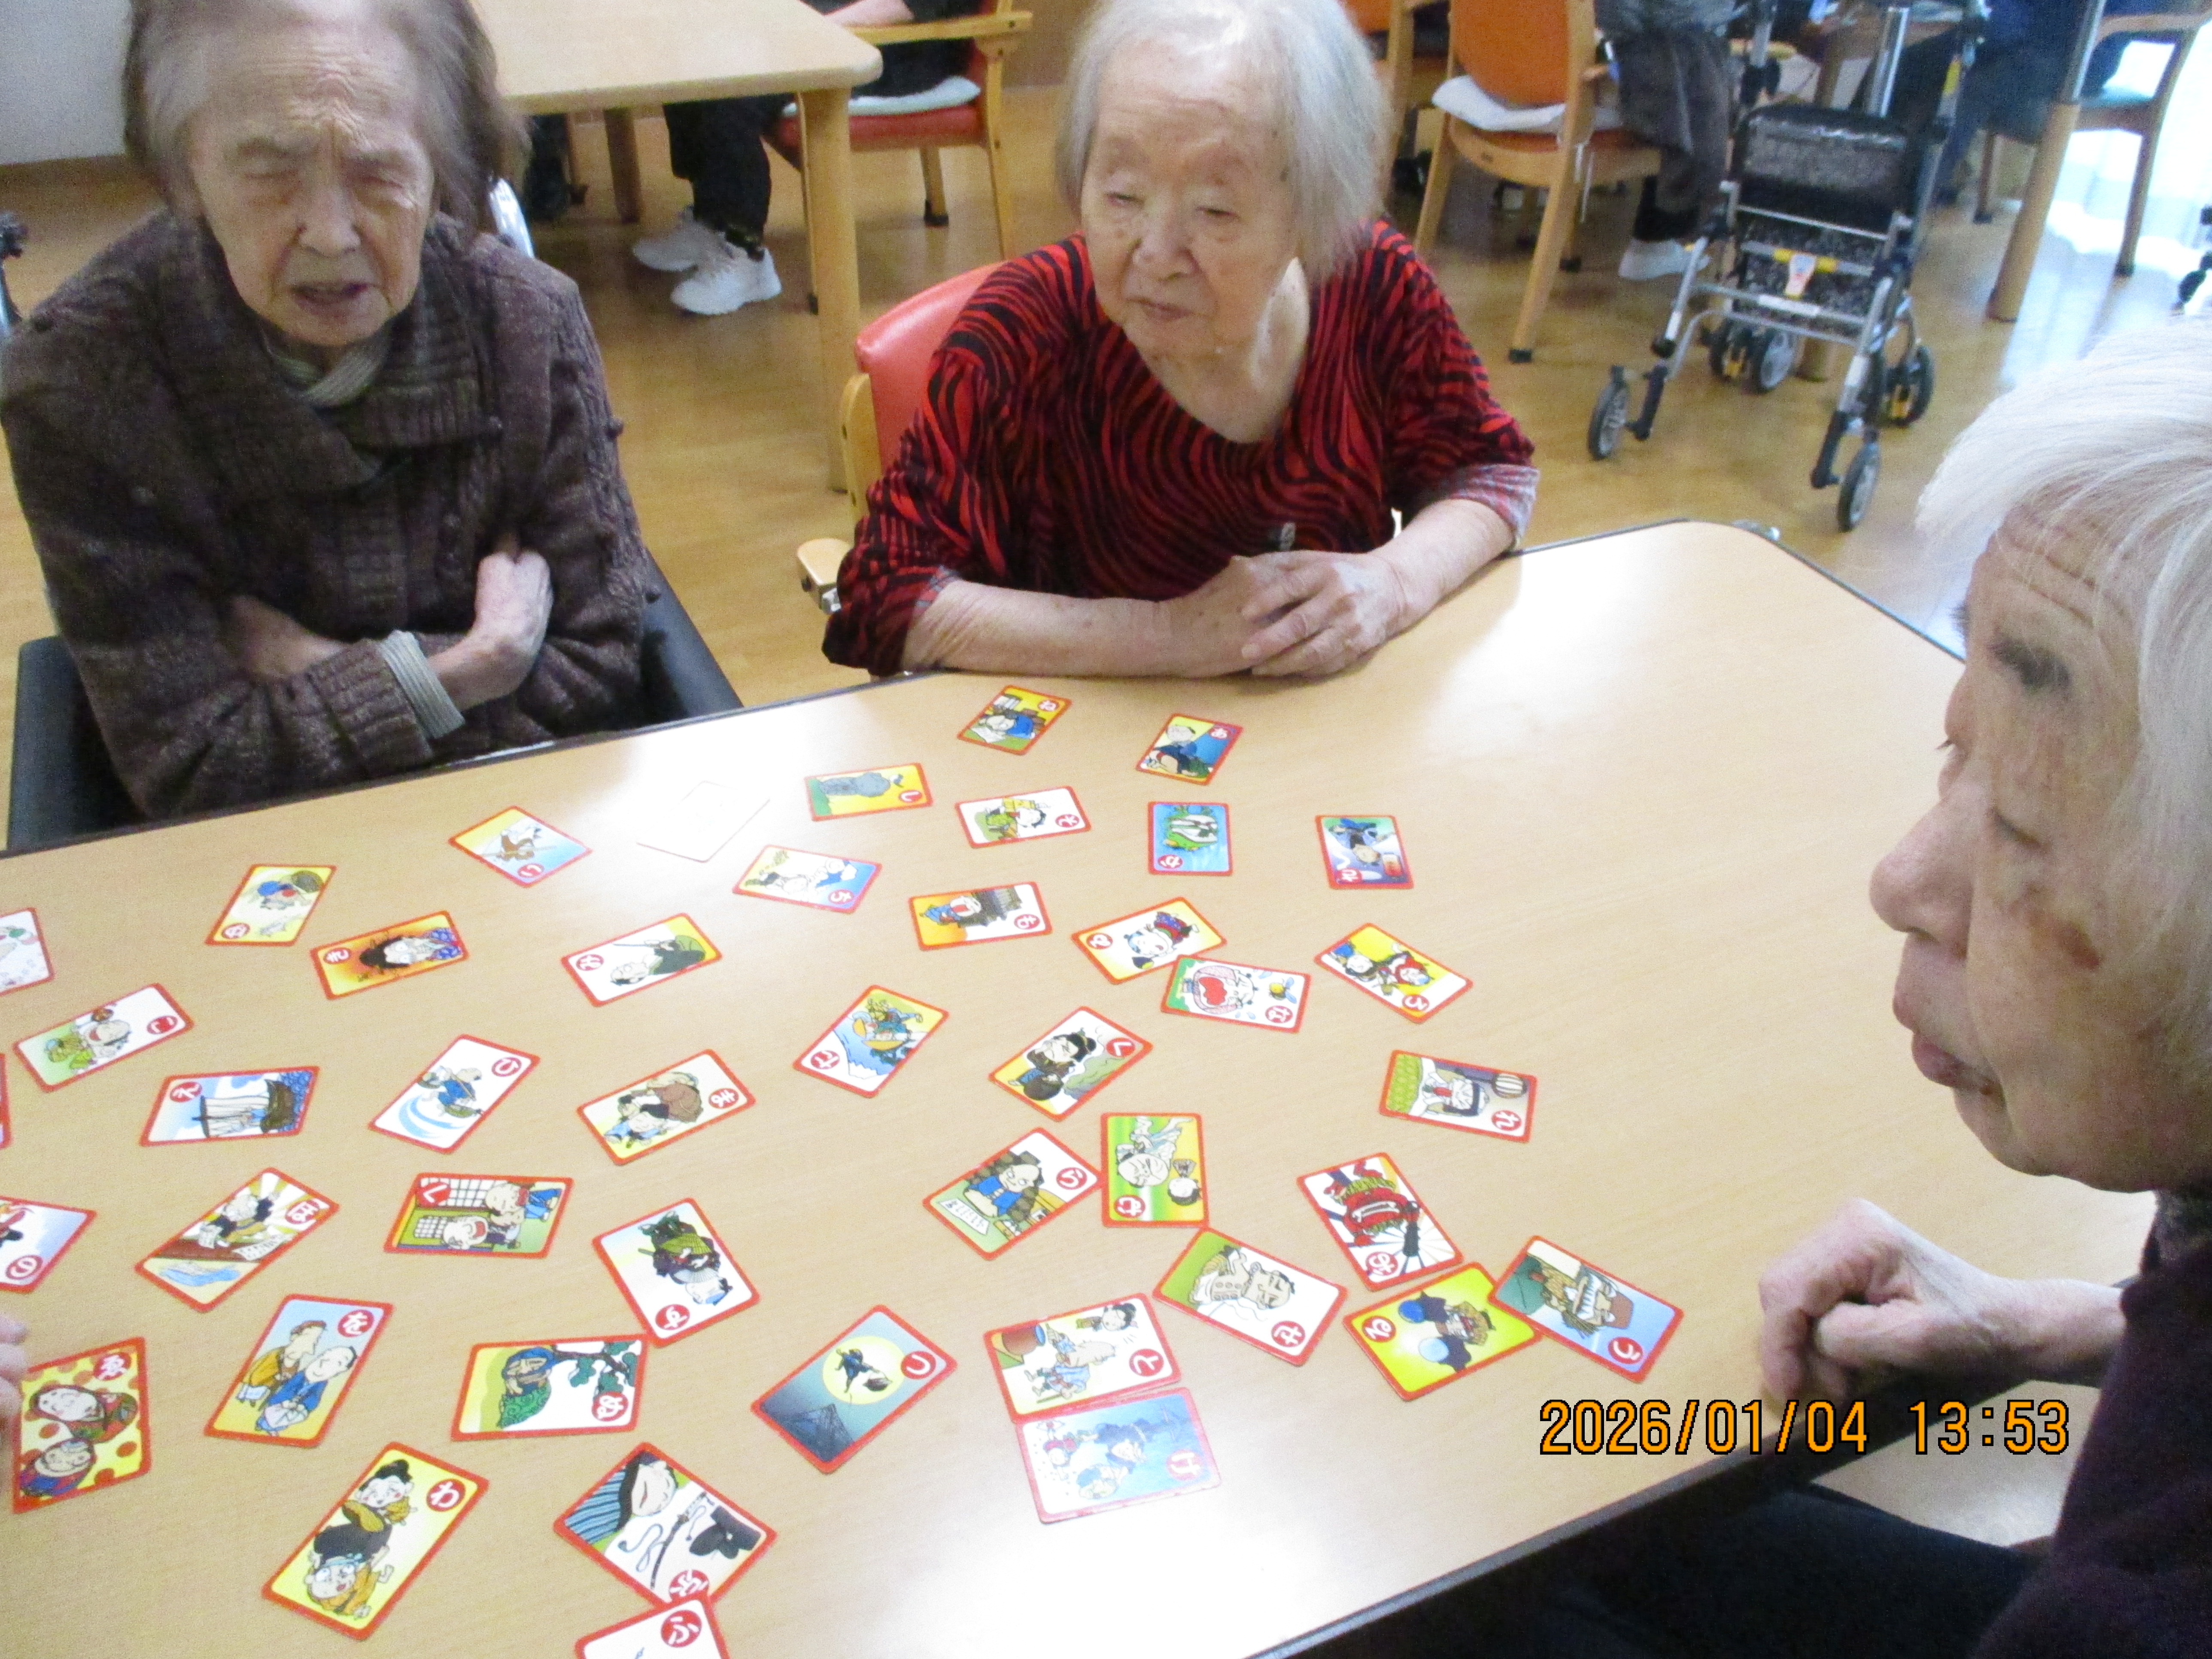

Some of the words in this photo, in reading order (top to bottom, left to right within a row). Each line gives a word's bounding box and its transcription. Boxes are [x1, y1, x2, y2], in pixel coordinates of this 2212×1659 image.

[900, 791, 919, 801] し
[1059, 816, 1077, 826] そ
[520, 863, 542, 876] い
[1161, 856, 1182, 867] か
[831, 892, 851, 902] ち
[1016, 916, 1036, 930] も
[1091, 934, 1111, 947] ゐ
[327, 951, 348, 962] き
[580, 954, 603, 969] み
[1405, 997, 1427, 1010] ろ
[1269, 1007, 1289, 1022] な
[151, 1017, 174, 1033] こ
[1114, 1042, 1132, 1056] く
[495, 1058, 518, 1073] ひ
[815, 1052, 838, 1067] た
[173, 1085, 201, 1100] え
[711, 1090, 734, 1107] ま
[1496, 1111, 1519, 1128] れ
[1060, 1170, 1082, 1187] ら
[423, 1183, 446, 1202] へ
[288, 1202, 315, 1221] ほ
[1118, 1197, 1142, 1215] む
[11, 1258, 36, 1276] の
[1370, 1253, 1394, 1273] お
[343, 1313, 368, 1334] を
[665, 1307, 687, 1328] す
[1274, 1326, 1301, 1345] せ
[1365, 1319, 1391, 1339] る
[1613, 1341, 1640, 1360] う
[100, 1355, 126, 1378] ゑ
[907, 1354, 930, 1375] つ
[1133, 1355, 1158, 1374] と
[597, 1396, 623, 1419] ぬ
[431, 1482, 458, 1507] わ
[668, 1616, 699, 1644] ふ
